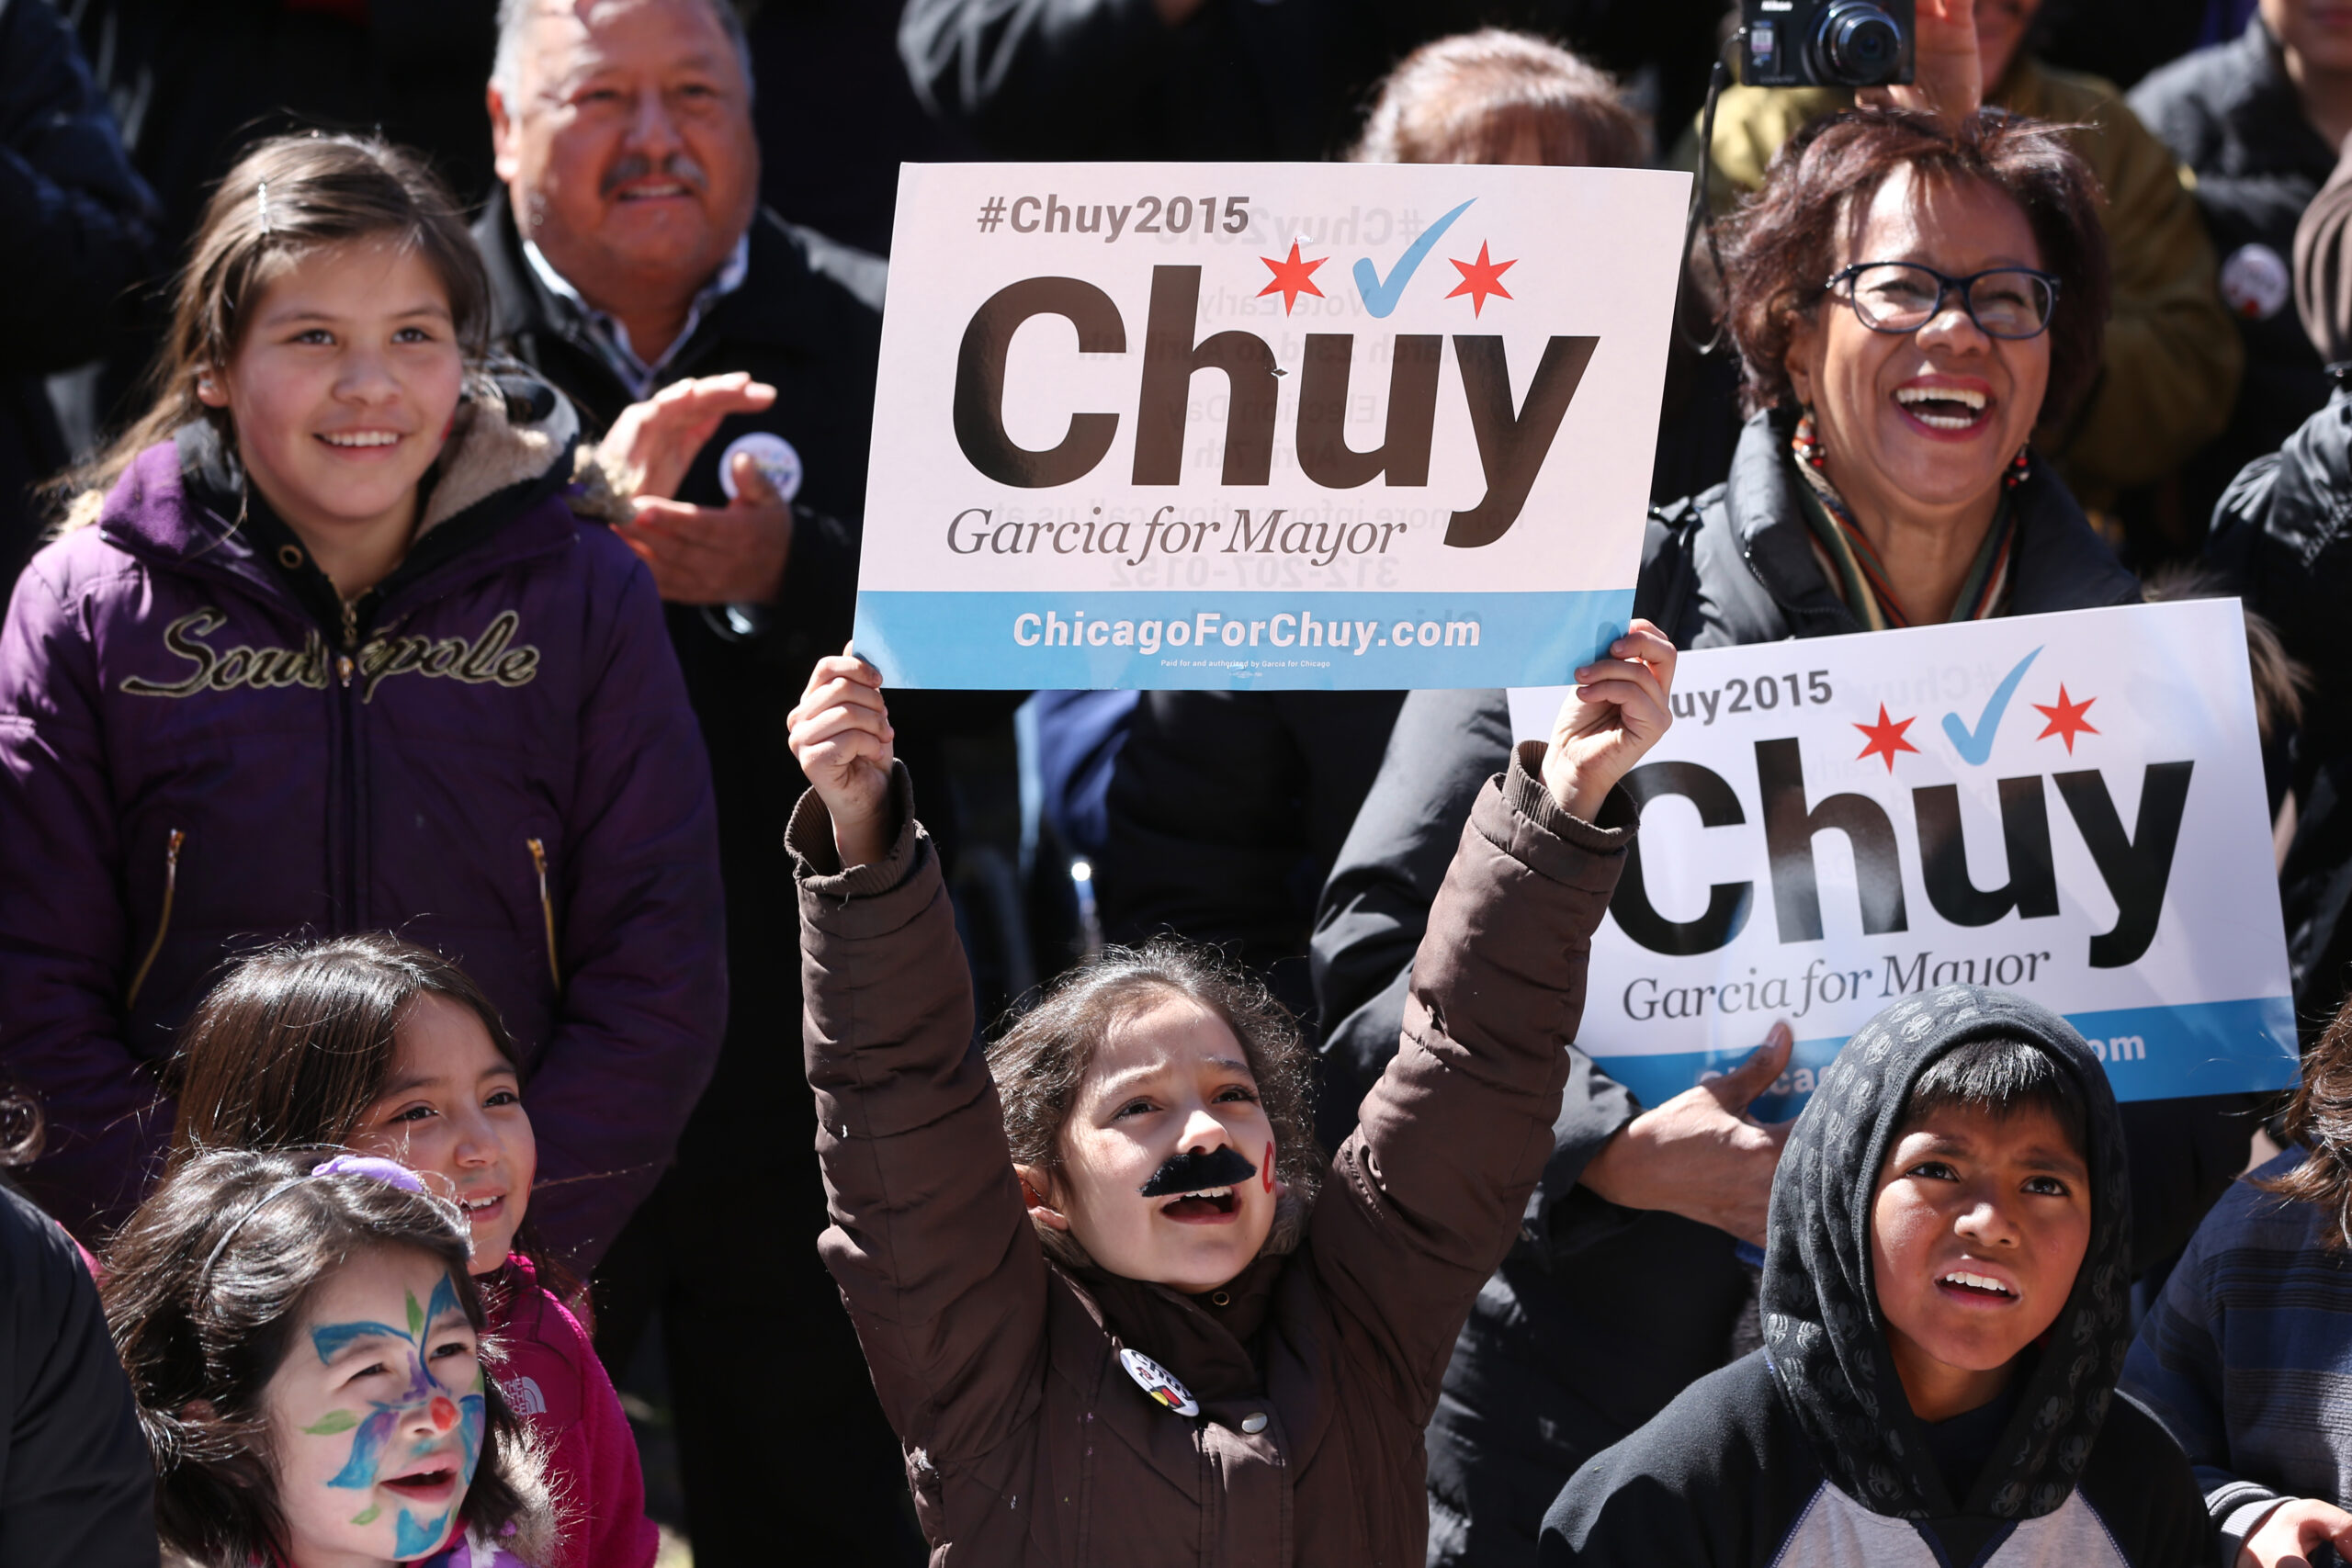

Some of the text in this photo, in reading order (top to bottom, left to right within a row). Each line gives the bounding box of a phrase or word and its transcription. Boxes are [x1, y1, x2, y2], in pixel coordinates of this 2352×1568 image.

[976, 194, 1250, 244] #Chuy2015
[952, 264, 1601, 548] Chuy
[946, 505, 1408, 567] Garcia for Mayor
[1012, 610, 1483, 657] ChicagoForChuy.com
[1160, 660, 1178, 668] Paid
[1180, 660, 1191, 668] for
[1193, 660, 1207, 668] and
[1250, 660, 1261, 670] by
[1261, 660, 1286, 669] Garcia
[1287, 660, 1298, 669] for
[1300, 660, 1331, 670] Chicago
[1670, 670, 1833, 726] uy2015
[1608, 736, 2196, 970] Chuy
[1622, 967, 1792, 1021] Garcia
[1792, 958, 1873, 1019] for
